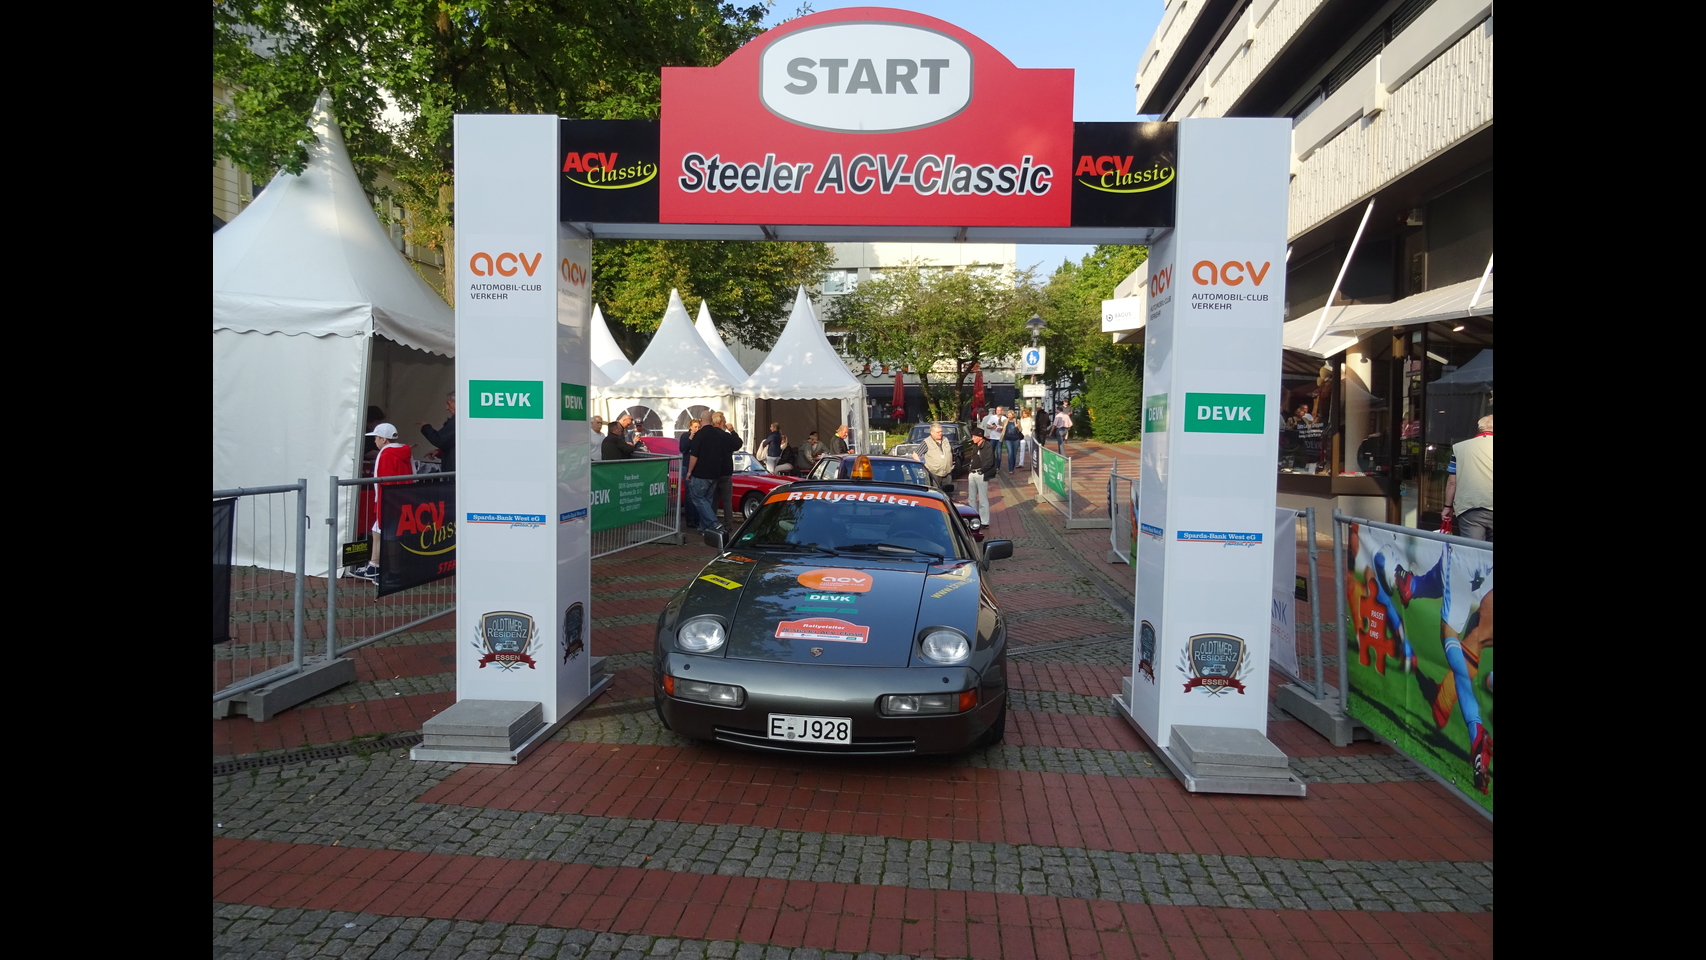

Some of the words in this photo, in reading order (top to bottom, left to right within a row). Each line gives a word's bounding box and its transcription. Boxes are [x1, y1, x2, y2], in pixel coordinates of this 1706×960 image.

[783, 57, 949, 95] START
[563, 151, 618, 173] ACV
[1075, 155, 1134, 177] ACV
[587, 162, 654, 184] Classic
[678, 152, 813, 194] Steeler
[815, 154, 1053, 196] ACV-Classic
[1100, 165, 1170, 187] Classic
[469, 252, 542, 277] acv
[561, 258, 587, 289] acv
[1151, 263, 1173, 298] acv
[1192, 260, 1270, 286] acv
[1191, 293, 1269, 301] AUTOMOBIL-CLUB
[1191, 302, 1232, 310] VERKEHR
[480, 392, 531, 407] DEVK
[565, 395, 583, 410] DEVK
[1148, 407, 1163, 421] DEVK
[1197, 405, 1252, 421] DEVK
[649, 482, 665, 496] DEVK
[590, 489, 611, 505] DEVK
[787, 491, 919, 507] Rallyeleiter
[396, 501, 445, 537] ACV
[1183, 532, 1226, 540] Sparda-Bank
[1371, 610, 1384, 620] PASST
[492, 618, 523, 633] OLDTIMER
[1370, 620, 1377, 628] ZU
[487, 627, 528, 638] RESIDENZ
[1370, 630, 1379, 639] UNS
[1200, 640, 1233, 655] OLDTIMER
[1194, 650, 1238, 662] RESIDENZ
[1201, 678, 1229, 686] ESSEN
